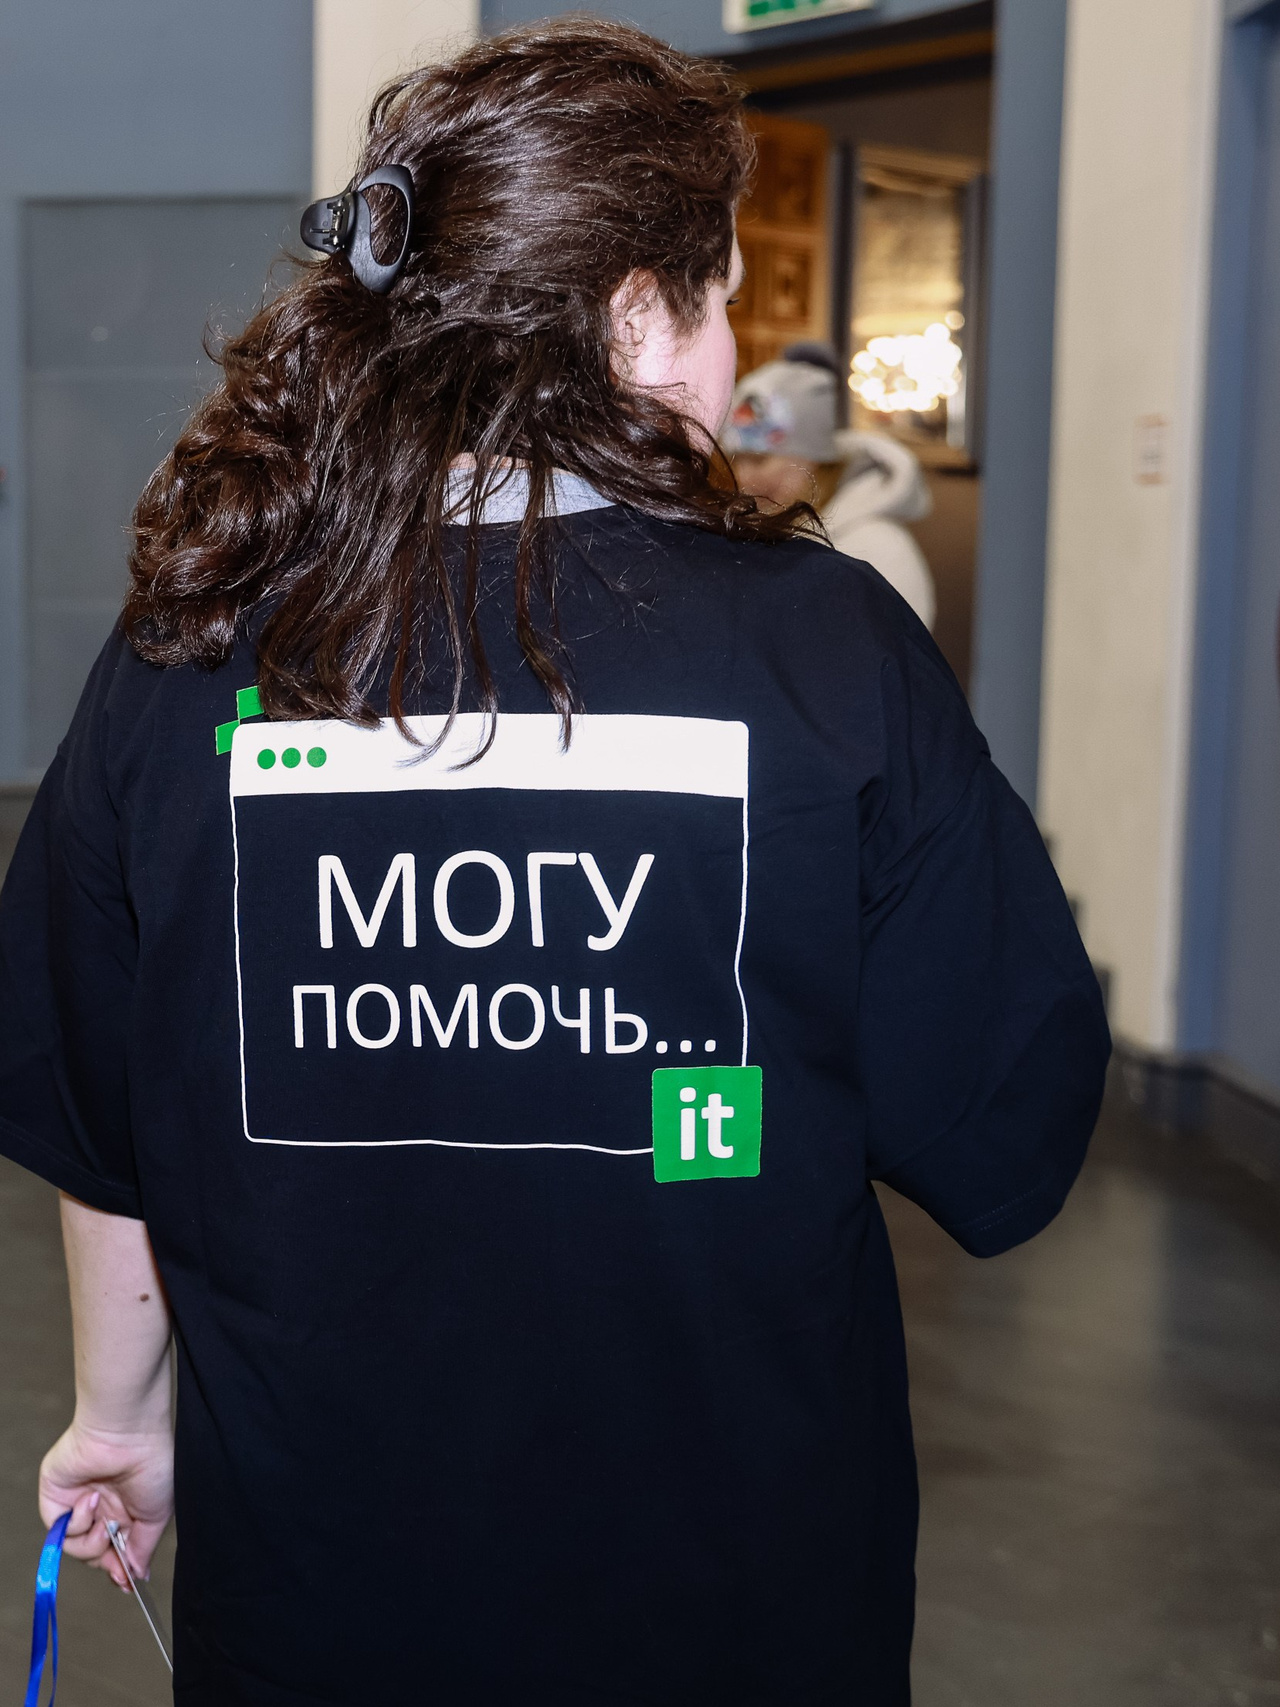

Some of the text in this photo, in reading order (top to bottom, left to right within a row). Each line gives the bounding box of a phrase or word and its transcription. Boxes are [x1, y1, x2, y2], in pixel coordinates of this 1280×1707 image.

[318, 850, 655, 951] МОГУ
[292, 983, 717, 1055] ПОМОЧЬ...
[680, 1087, 735, 1161] it
